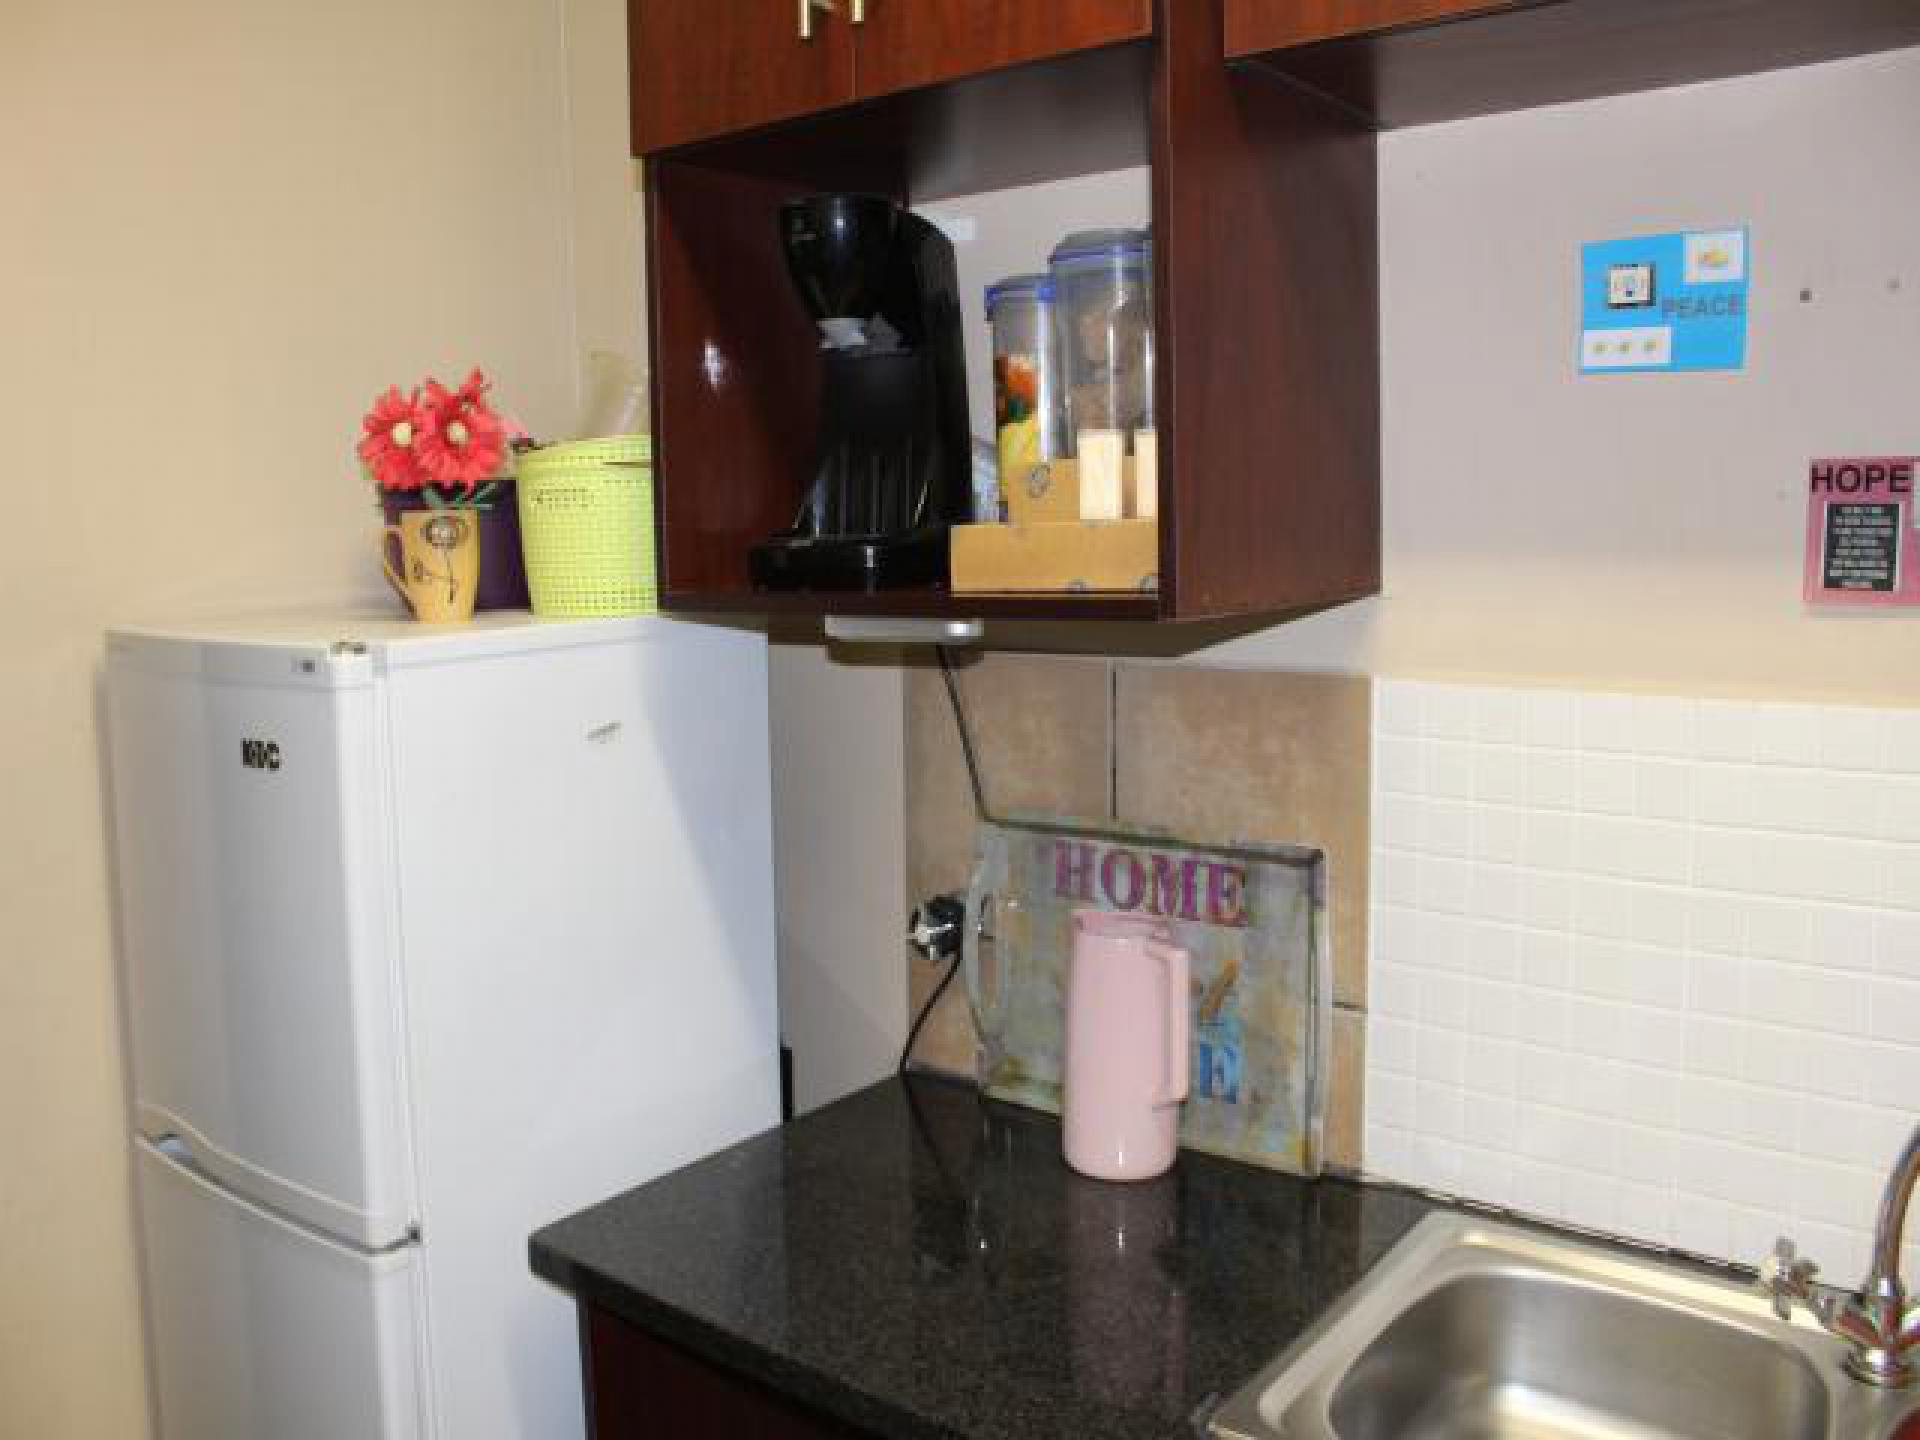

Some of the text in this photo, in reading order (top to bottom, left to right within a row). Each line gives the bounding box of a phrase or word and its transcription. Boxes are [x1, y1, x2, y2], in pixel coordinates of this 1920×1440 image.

[1661, 294, 1743, 318] PEACE
[1811, 464, 1911, 493] HOPE
[1055, 840, 1248, 927] HOME
